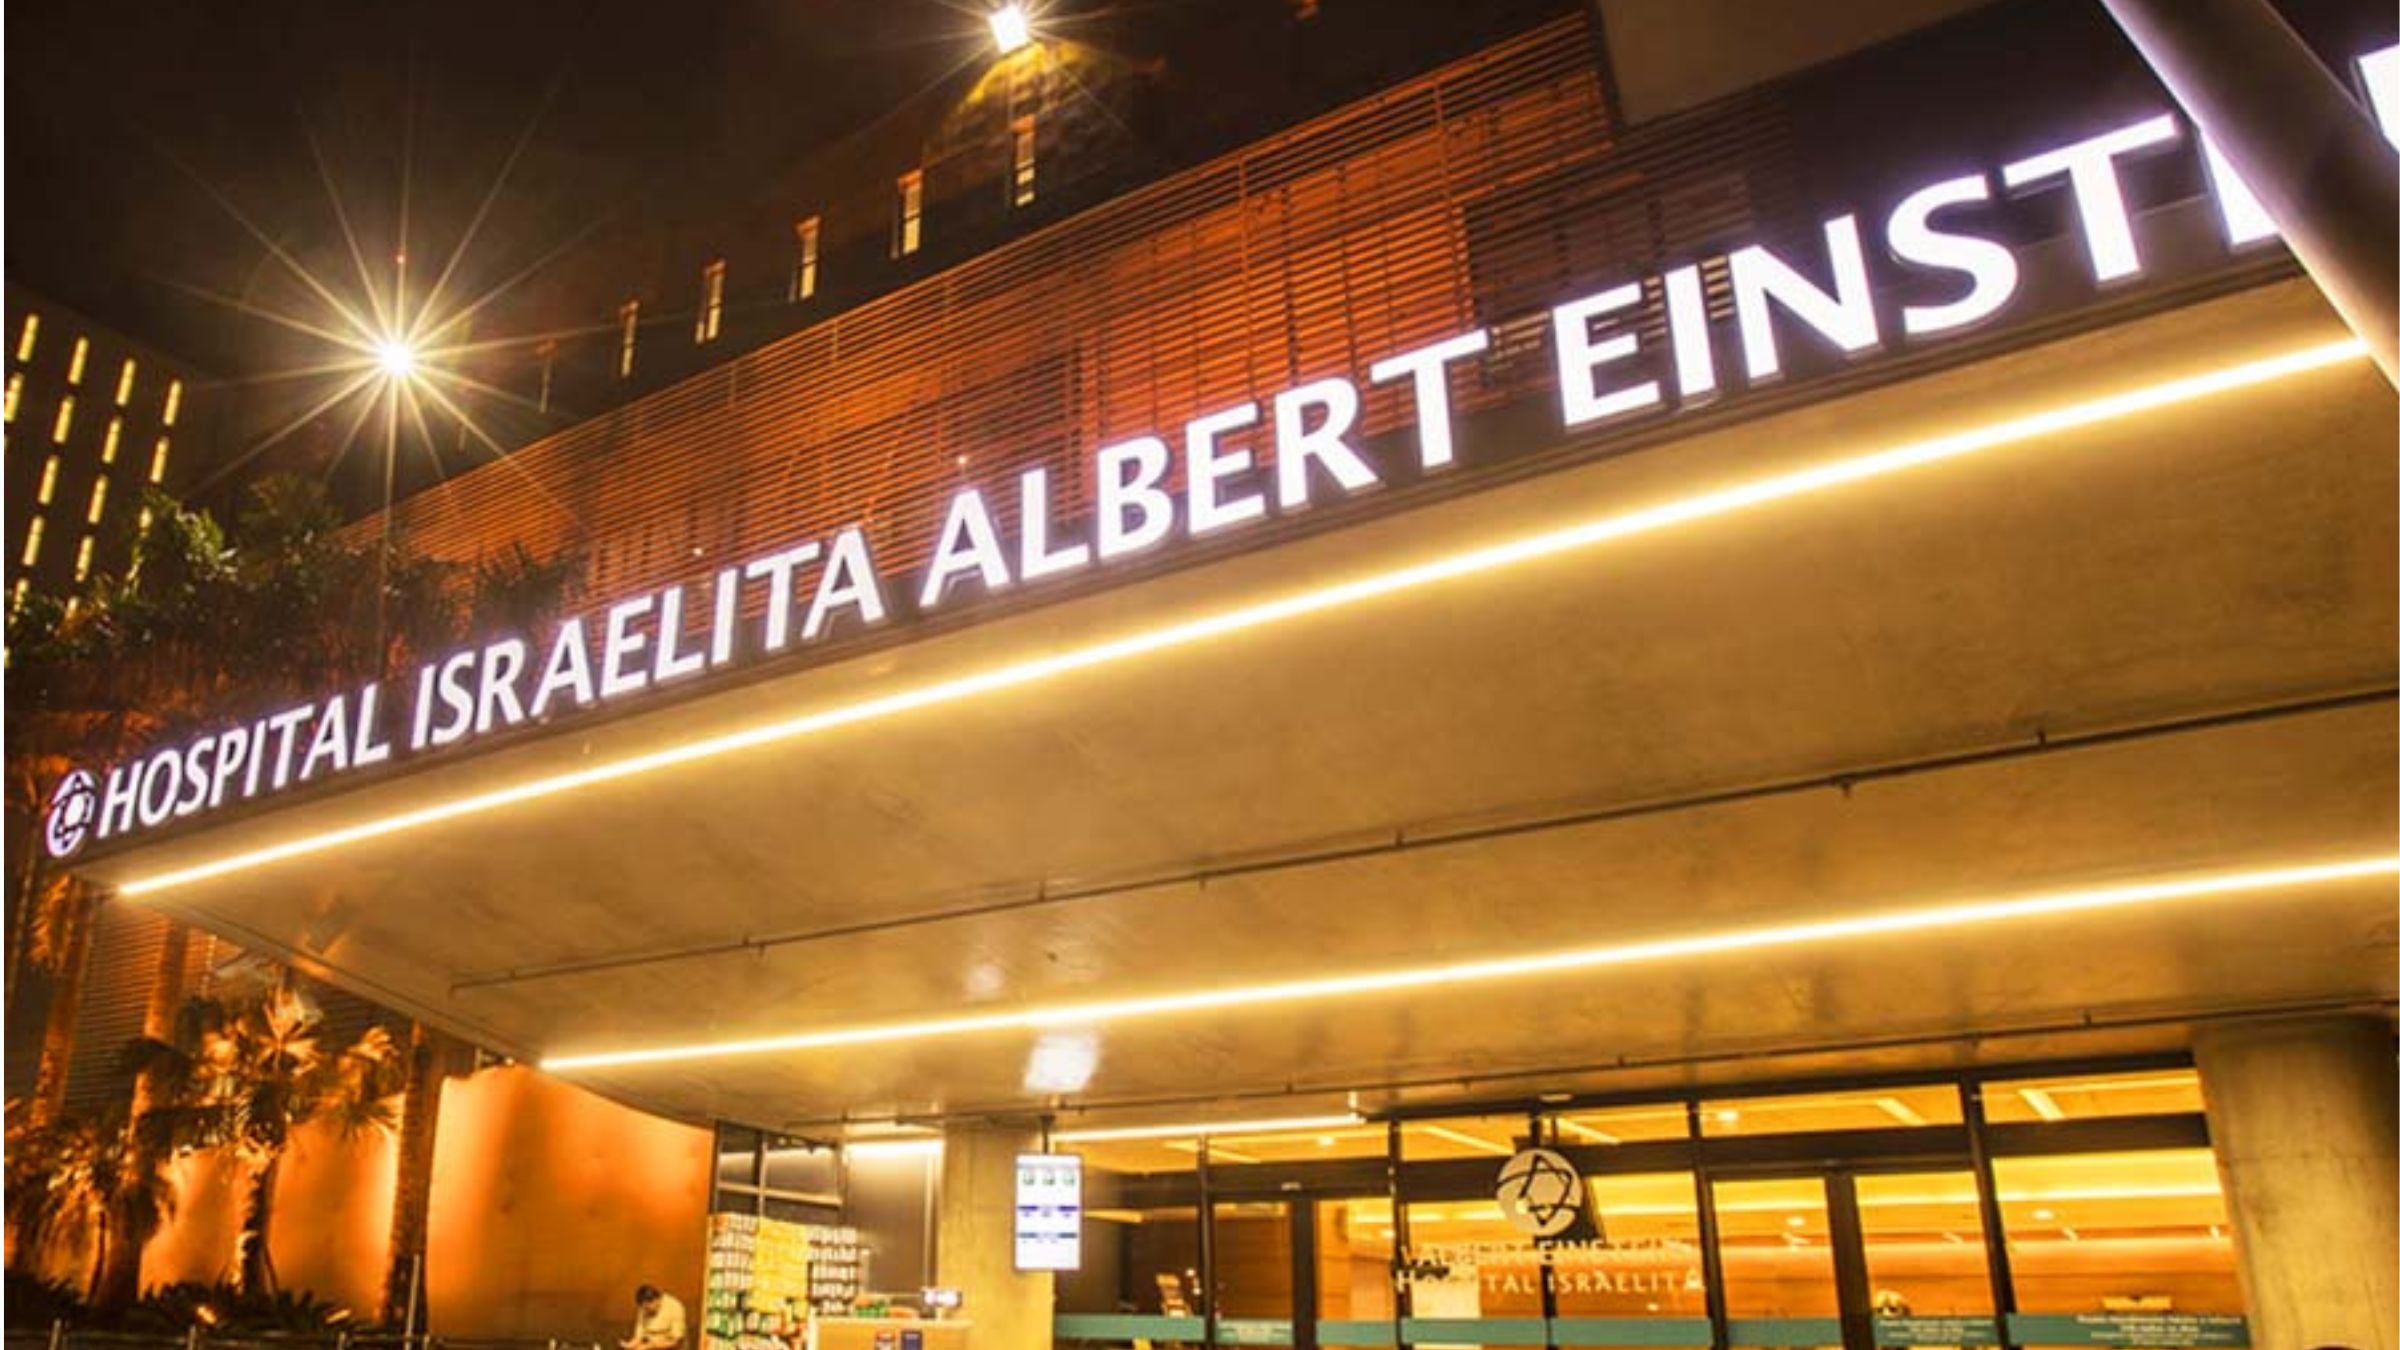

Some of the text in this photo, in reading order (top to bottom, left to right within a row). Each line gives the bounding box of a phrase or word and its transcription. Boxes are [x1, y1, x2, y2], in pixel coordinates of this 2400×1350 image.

[98, 683, 390, 838] HOSPITAL
[411, 526, 884, 749] ISRAELITA
[919, 329, 1488, 607] ALBERT
